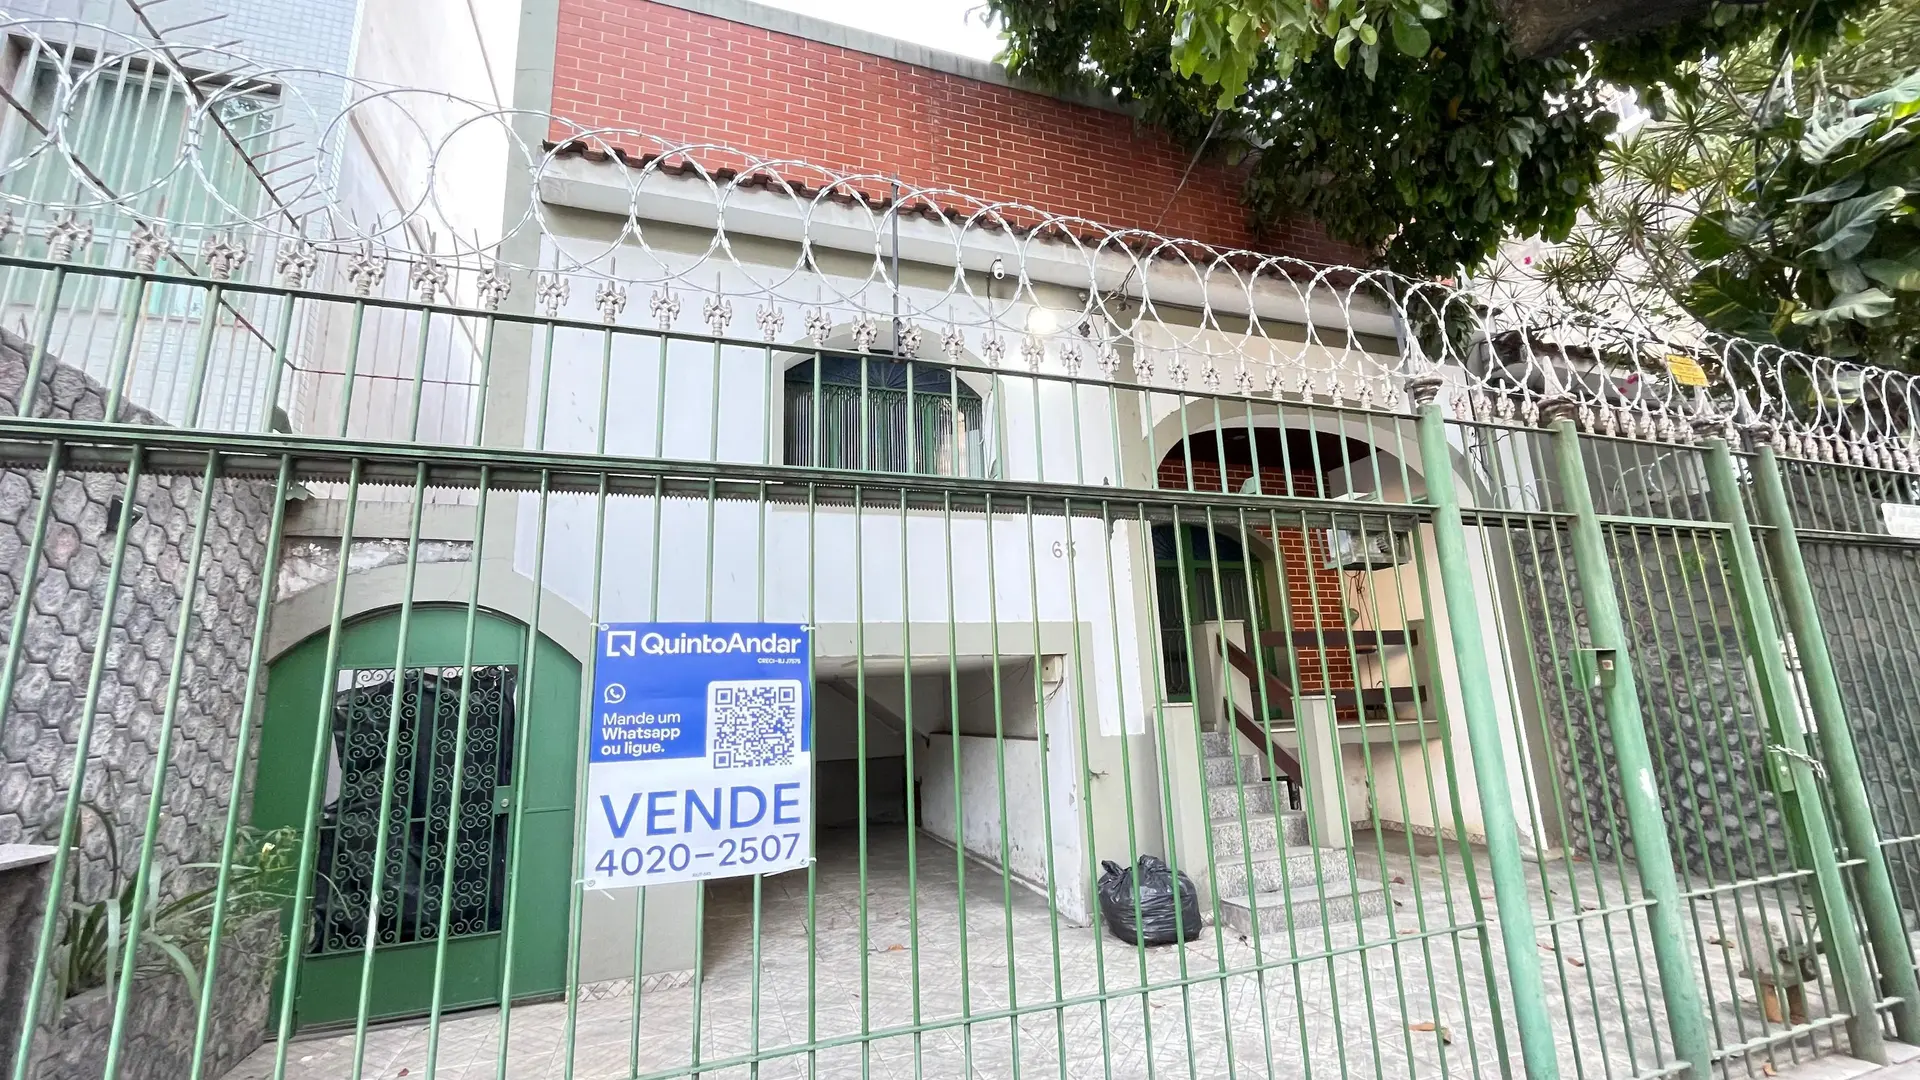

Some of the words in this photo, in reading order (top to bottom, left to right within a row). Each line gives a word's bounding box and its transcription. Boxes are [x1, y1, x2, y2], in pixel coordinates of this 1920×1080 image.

[641, 632, 801, 655] QuintoAndar
[603, 712, 655, 726] Mande
[658, 713, 681, 724] um
[602, 727, 681, 741] Whatsapp
[601, 745, 621, 755] ou
[624, 741, 665, 757] ligue.
[600, 782, 801, 839] VENDE
[595, 833, 801, 877] 4020-2507
